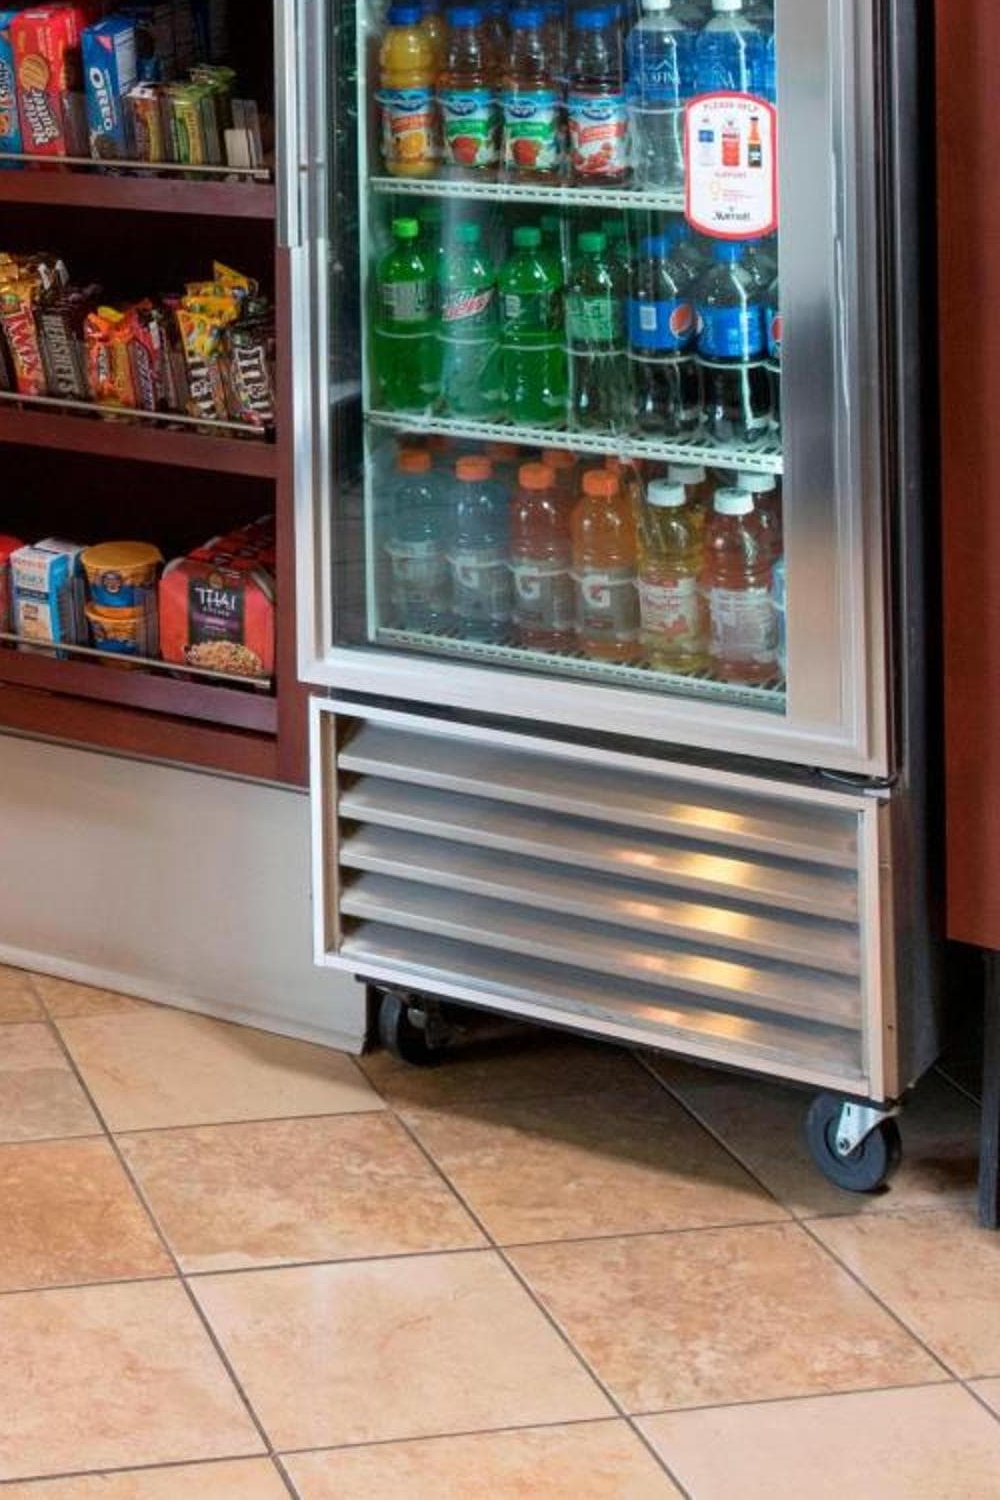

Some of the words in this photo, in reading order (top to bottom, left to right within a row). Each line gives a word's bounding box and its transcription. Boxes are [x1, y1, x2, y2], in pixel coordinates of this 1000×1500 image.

[89, 67, 113, 131] OREO
[194, 586, 237, 611] THAI
[583, 573, 611, 608] G
